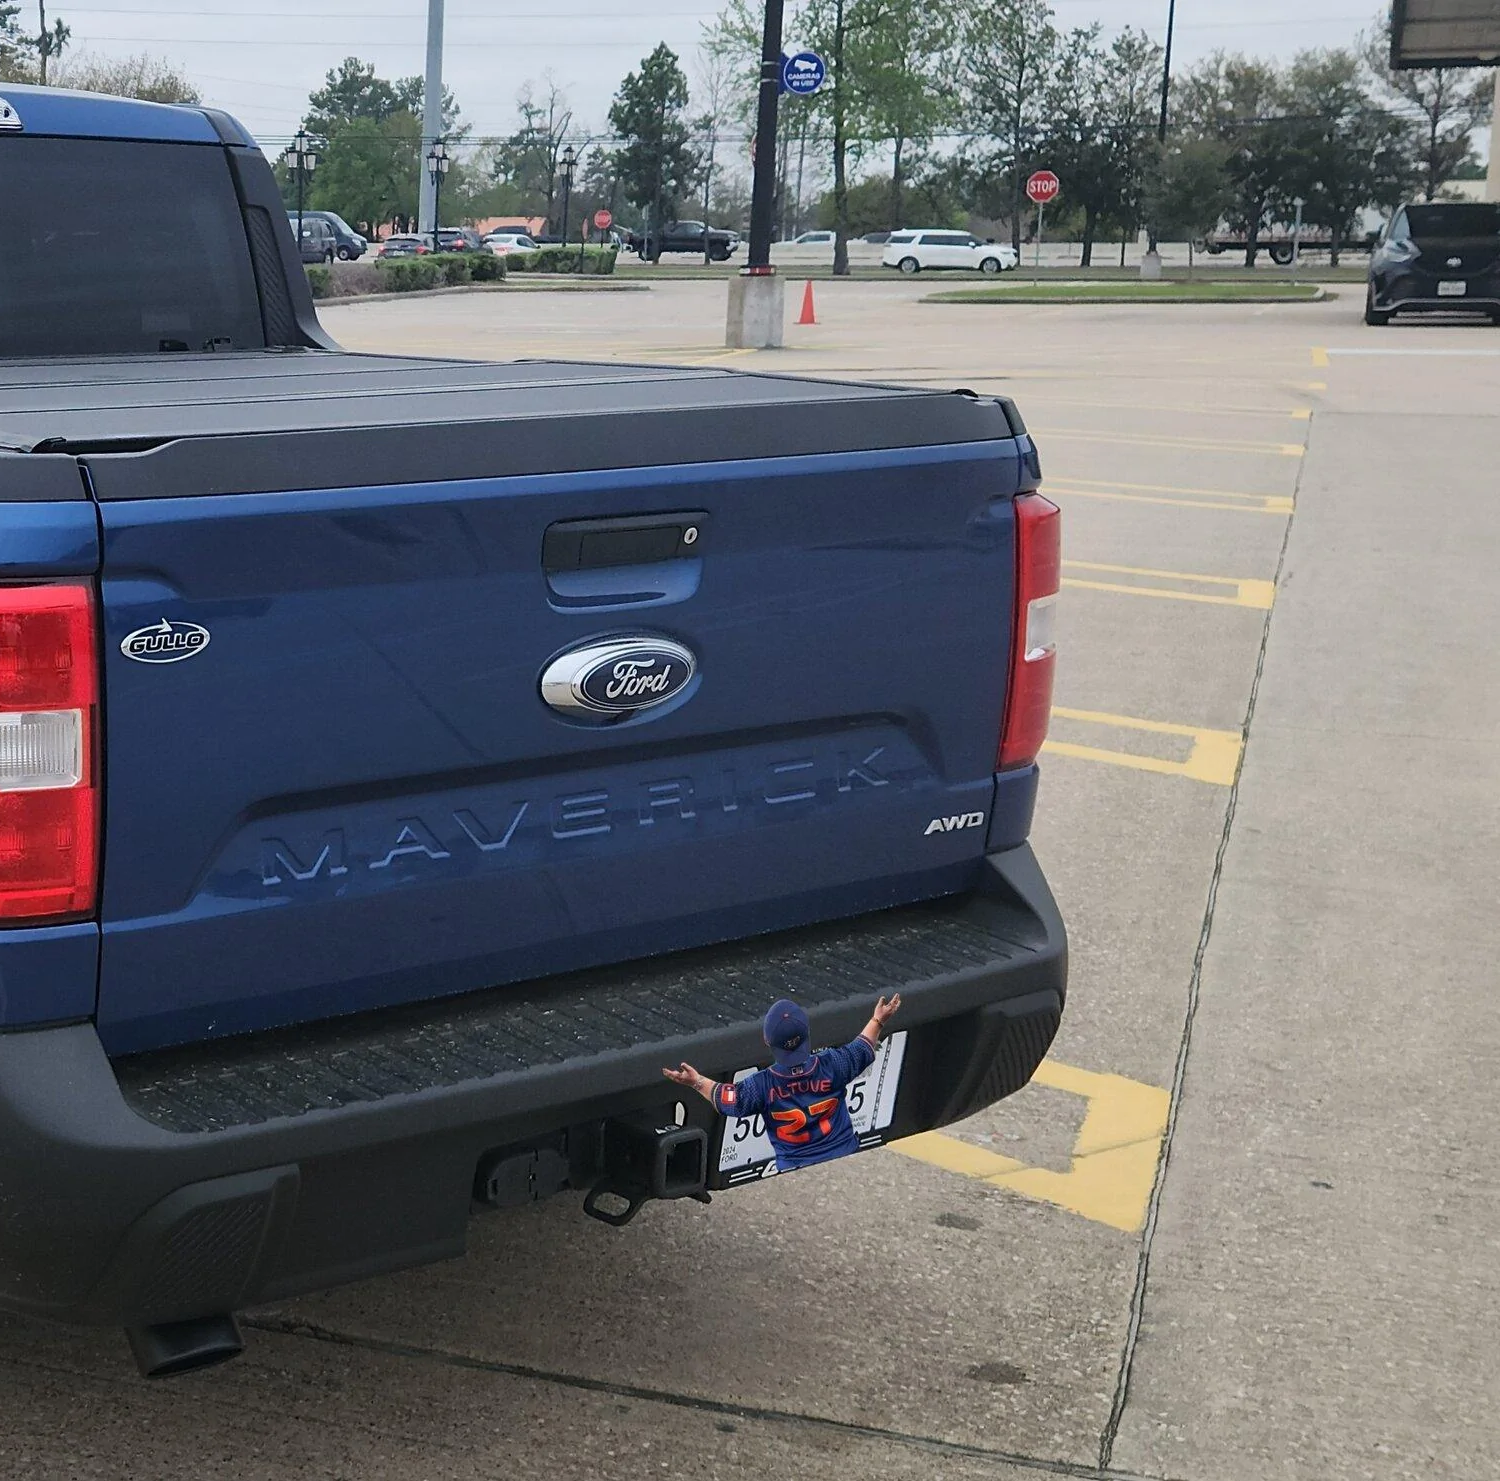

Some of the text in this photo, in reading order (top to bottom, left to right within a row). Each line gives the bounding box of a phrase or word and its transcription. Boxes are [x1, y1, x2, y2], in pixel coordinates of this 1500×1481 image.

[787, 72, 821, 80] CAMERAS
[1029, 180, 1056, 194] STOP
[128, 632, 206, 655] GULLO
[605, 658, 672, 699] Ford
[260, 745, 890, 886] MAVERICK
[923, 811, 985, 836] AWD
[768, 1078, 832, 1104] ALTUVE
[771, 1097, 839, 1145] 27
[720, 1153, 739, 1164] FORD
